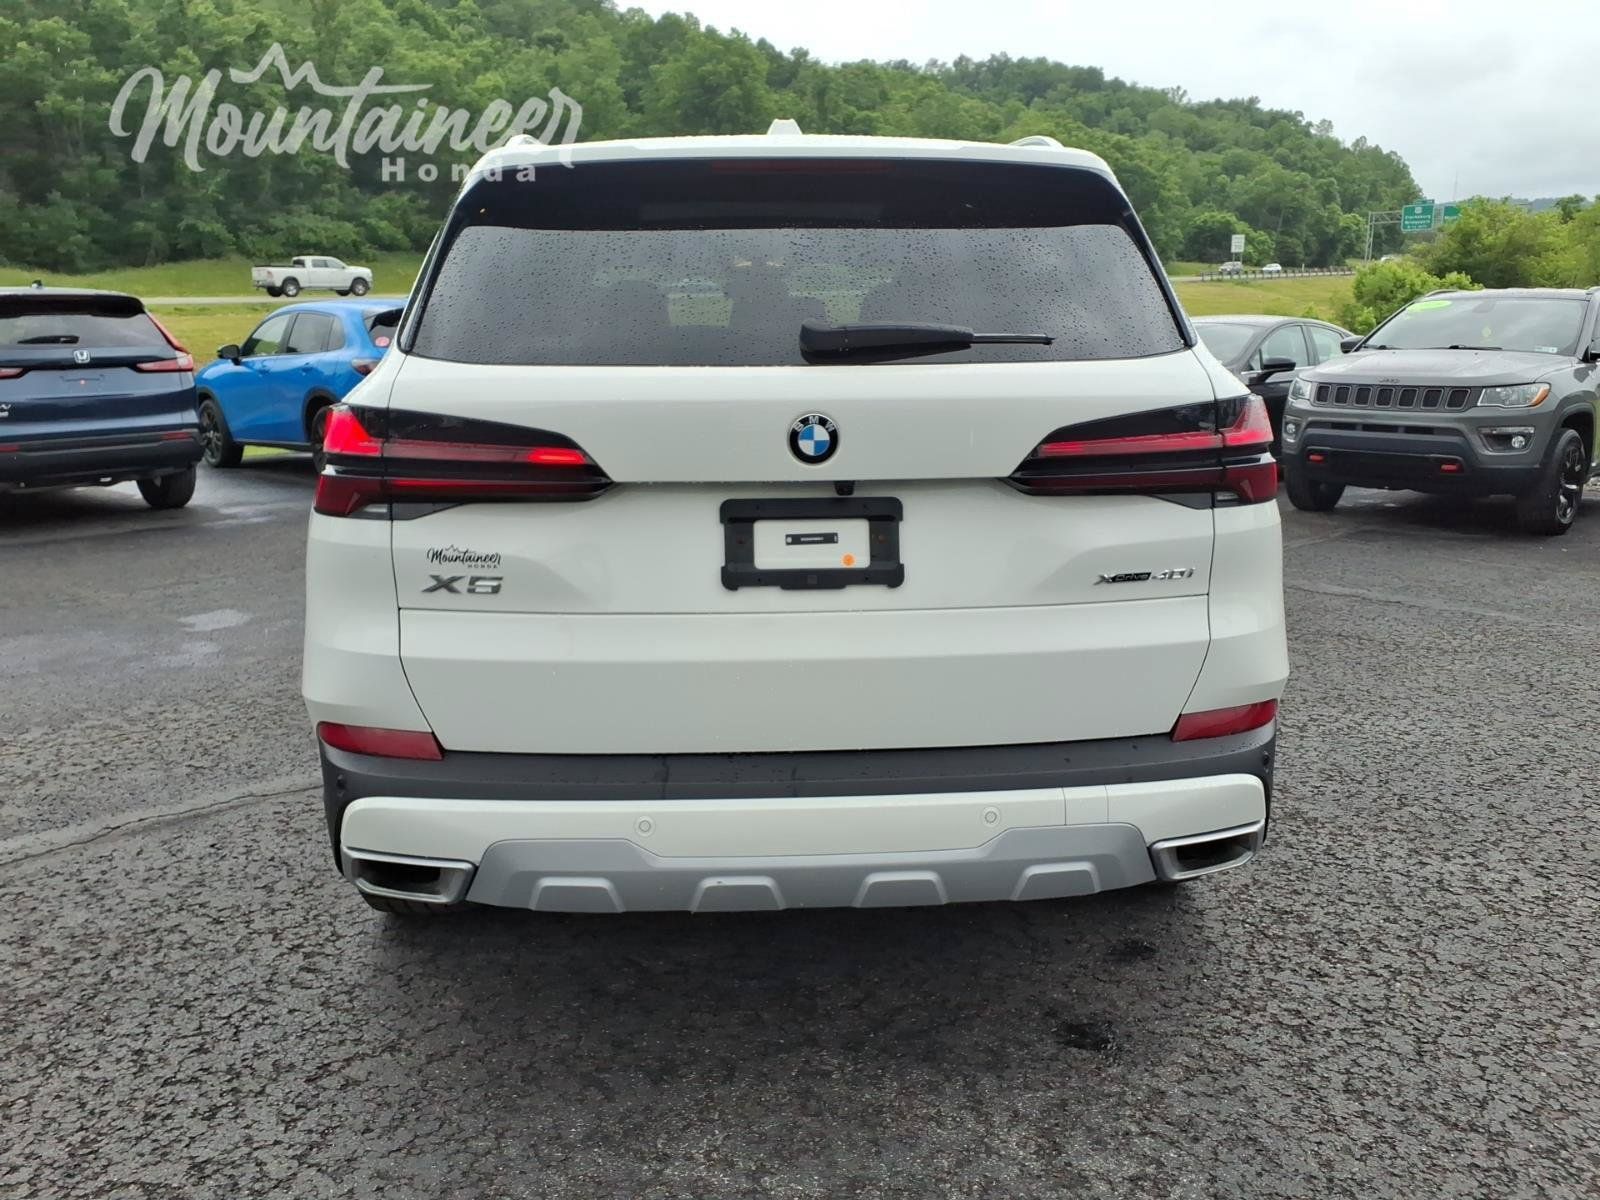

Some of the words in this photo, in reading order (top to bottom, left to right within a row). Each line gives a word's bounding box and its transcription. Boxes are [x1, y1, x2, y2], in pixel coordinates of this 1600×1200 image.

[793, 415, 835, 432] BMW
[427, 545, 502, 566] Mountaineer
[421, 574, 504, 594] X5
